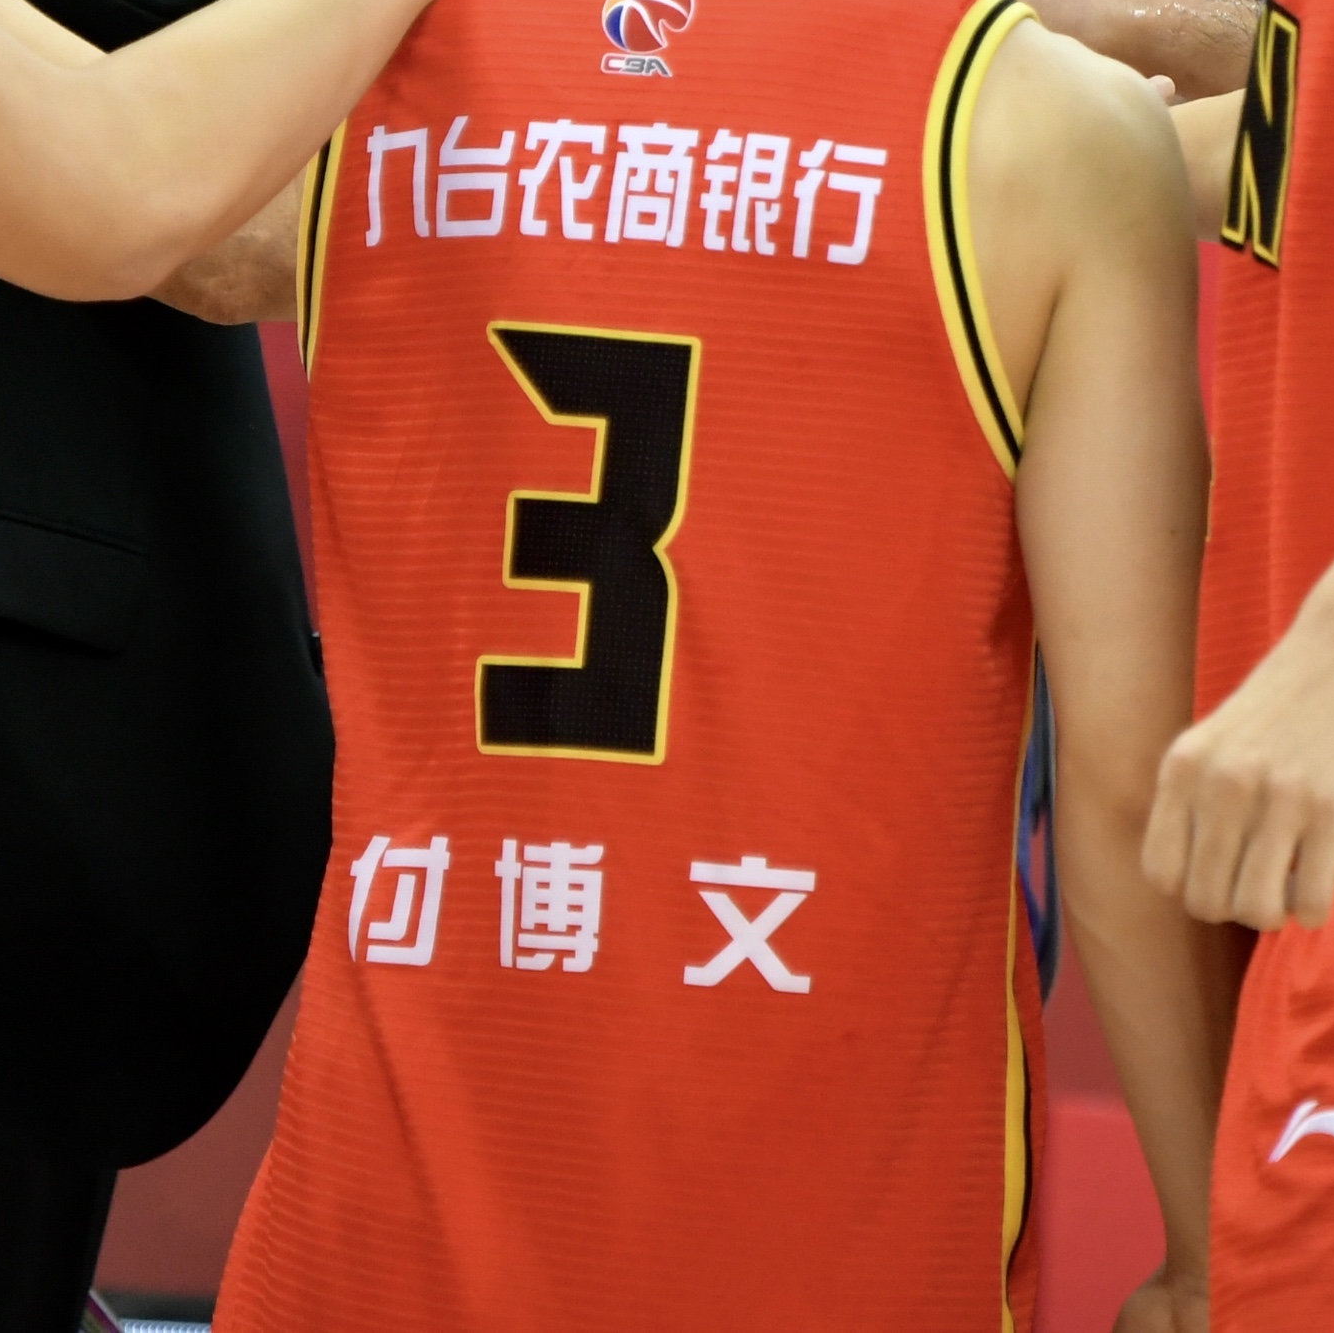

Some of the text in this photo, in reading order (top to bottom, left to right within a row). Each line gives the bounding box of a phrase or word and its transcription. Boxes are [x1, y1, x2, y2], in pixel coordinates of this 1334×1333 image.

[600, 52, 673, 78] CBA
[365, 115, 888, 266] 九台农商银行
[474, 320, 702, 766] 3
[347, 834, 817, 994] 付博文
